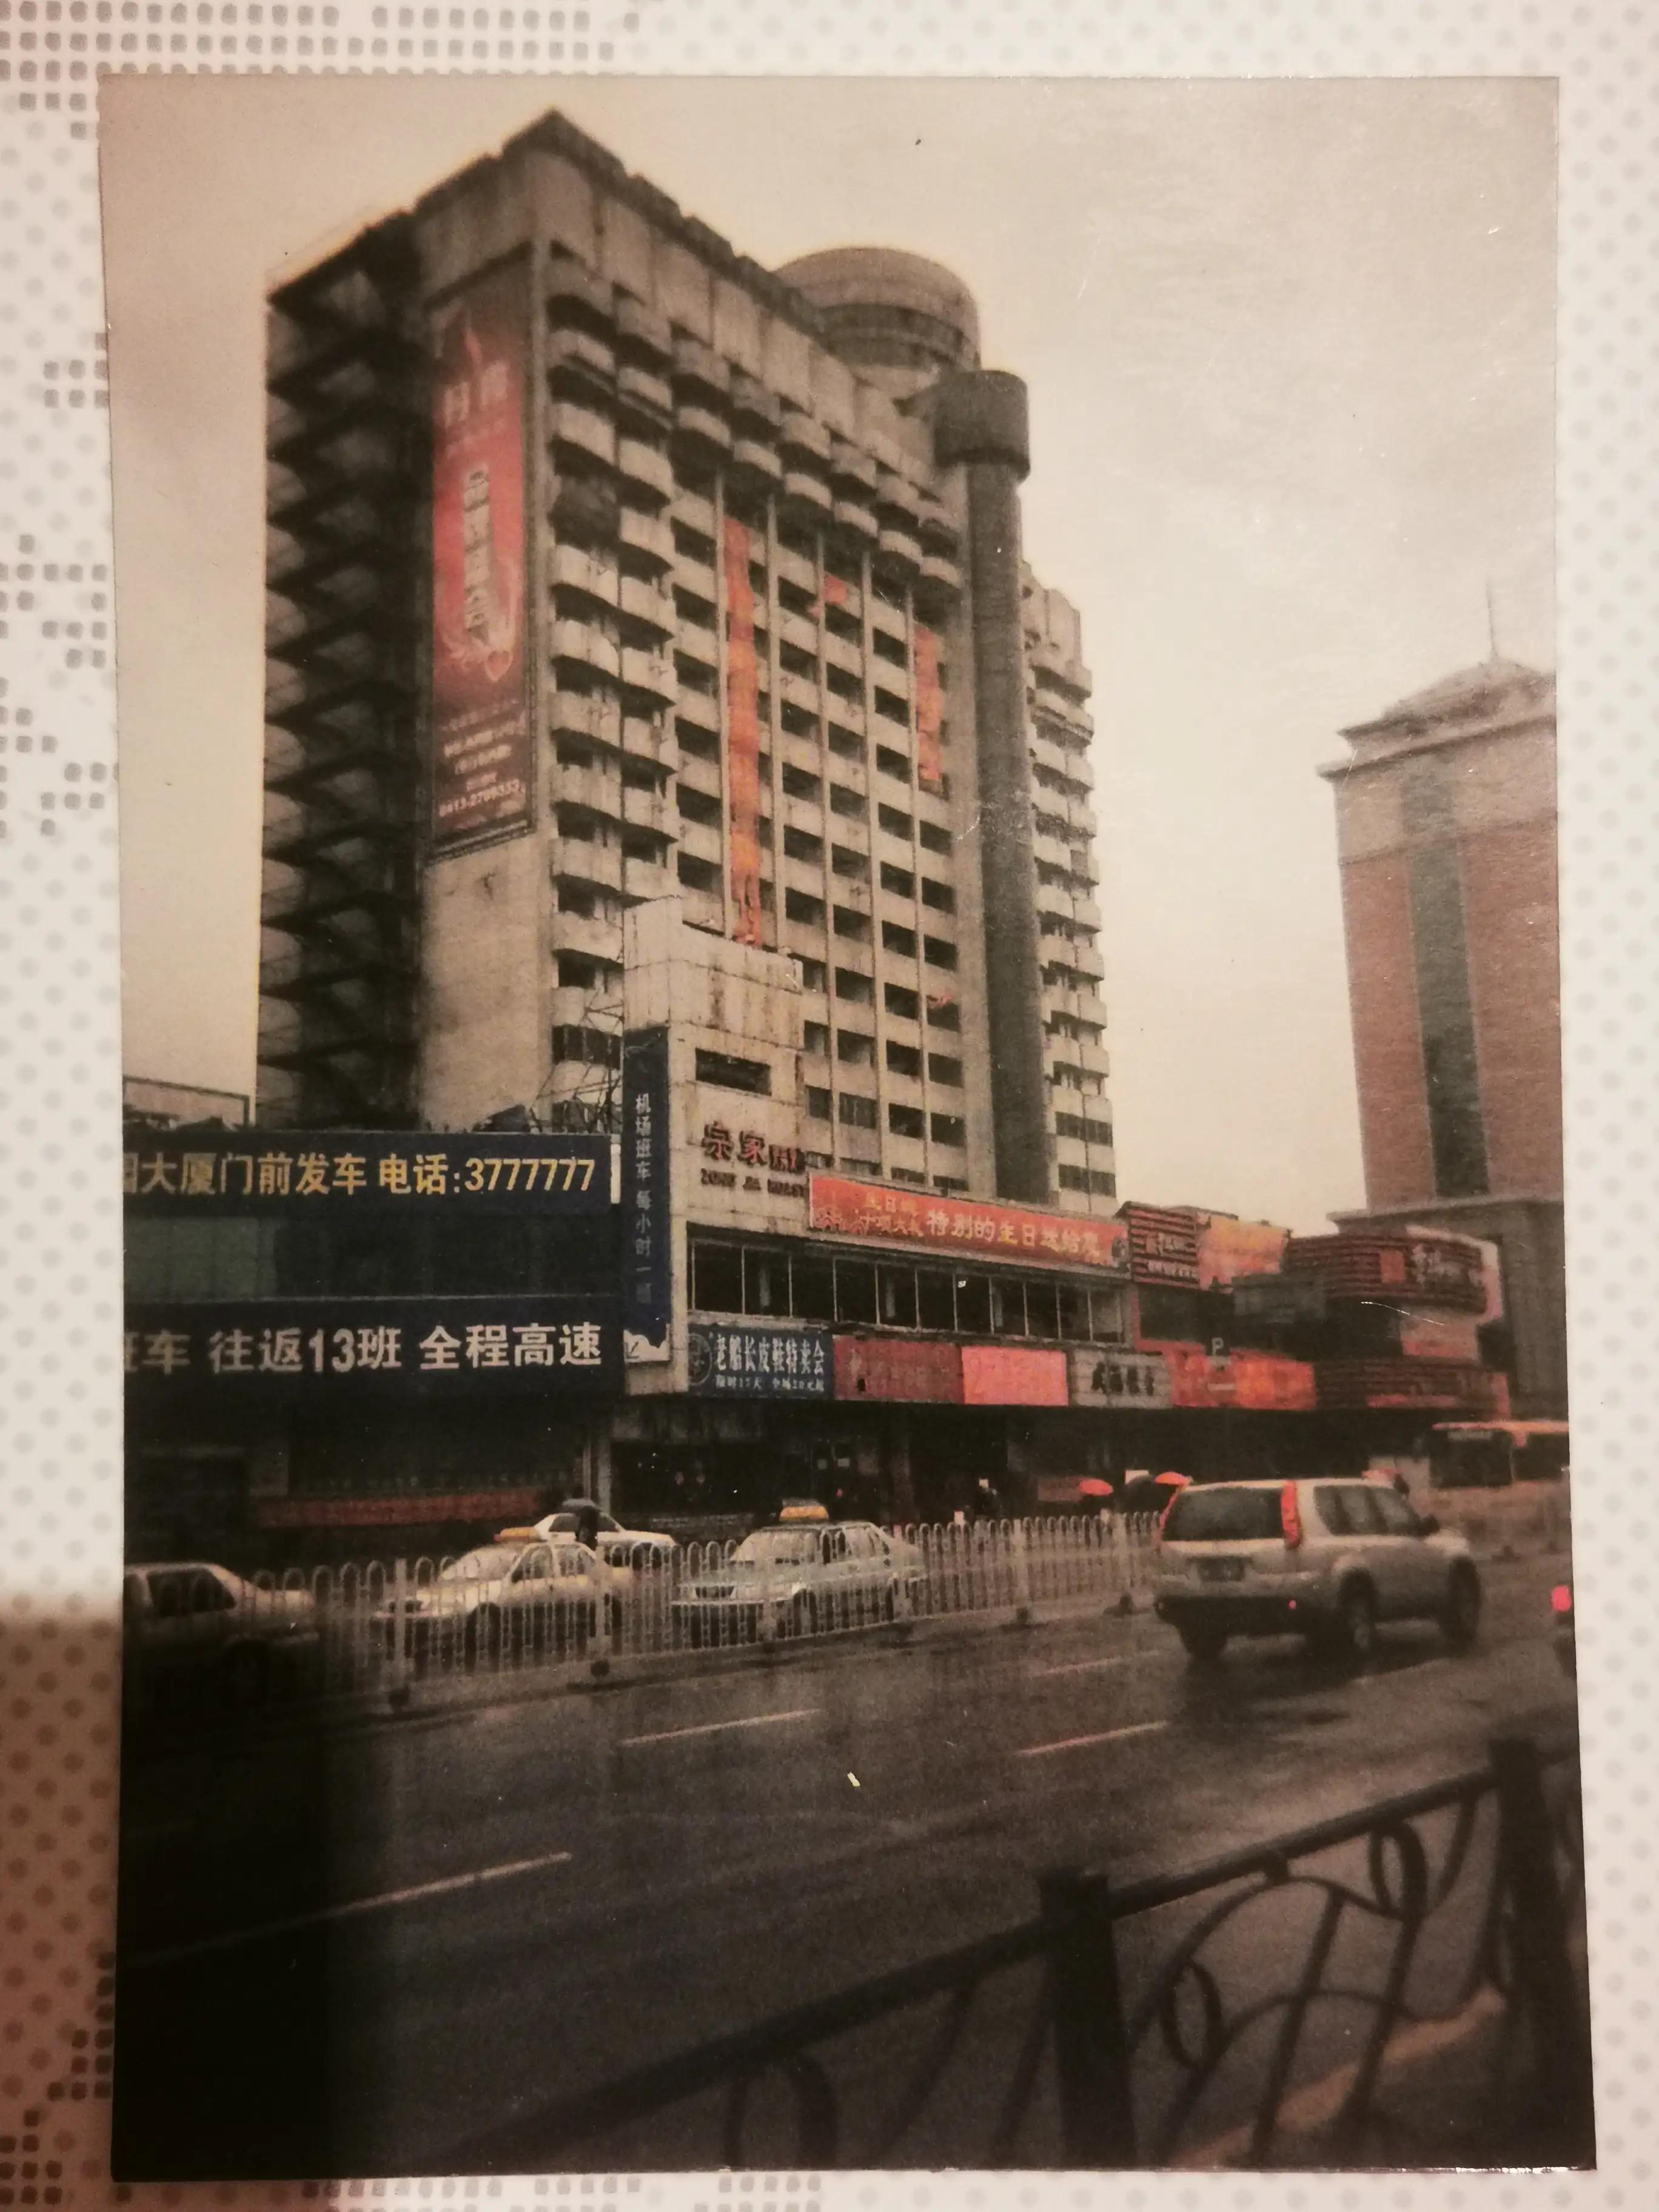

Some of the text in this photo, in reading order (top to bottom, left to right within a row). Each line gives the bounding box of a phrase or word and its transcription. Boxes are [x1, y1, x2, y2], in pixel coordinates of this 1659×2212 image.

[209, 1326, 402, 1374] 往返13班
[420, 1322, 603, 1370] 全程高速
